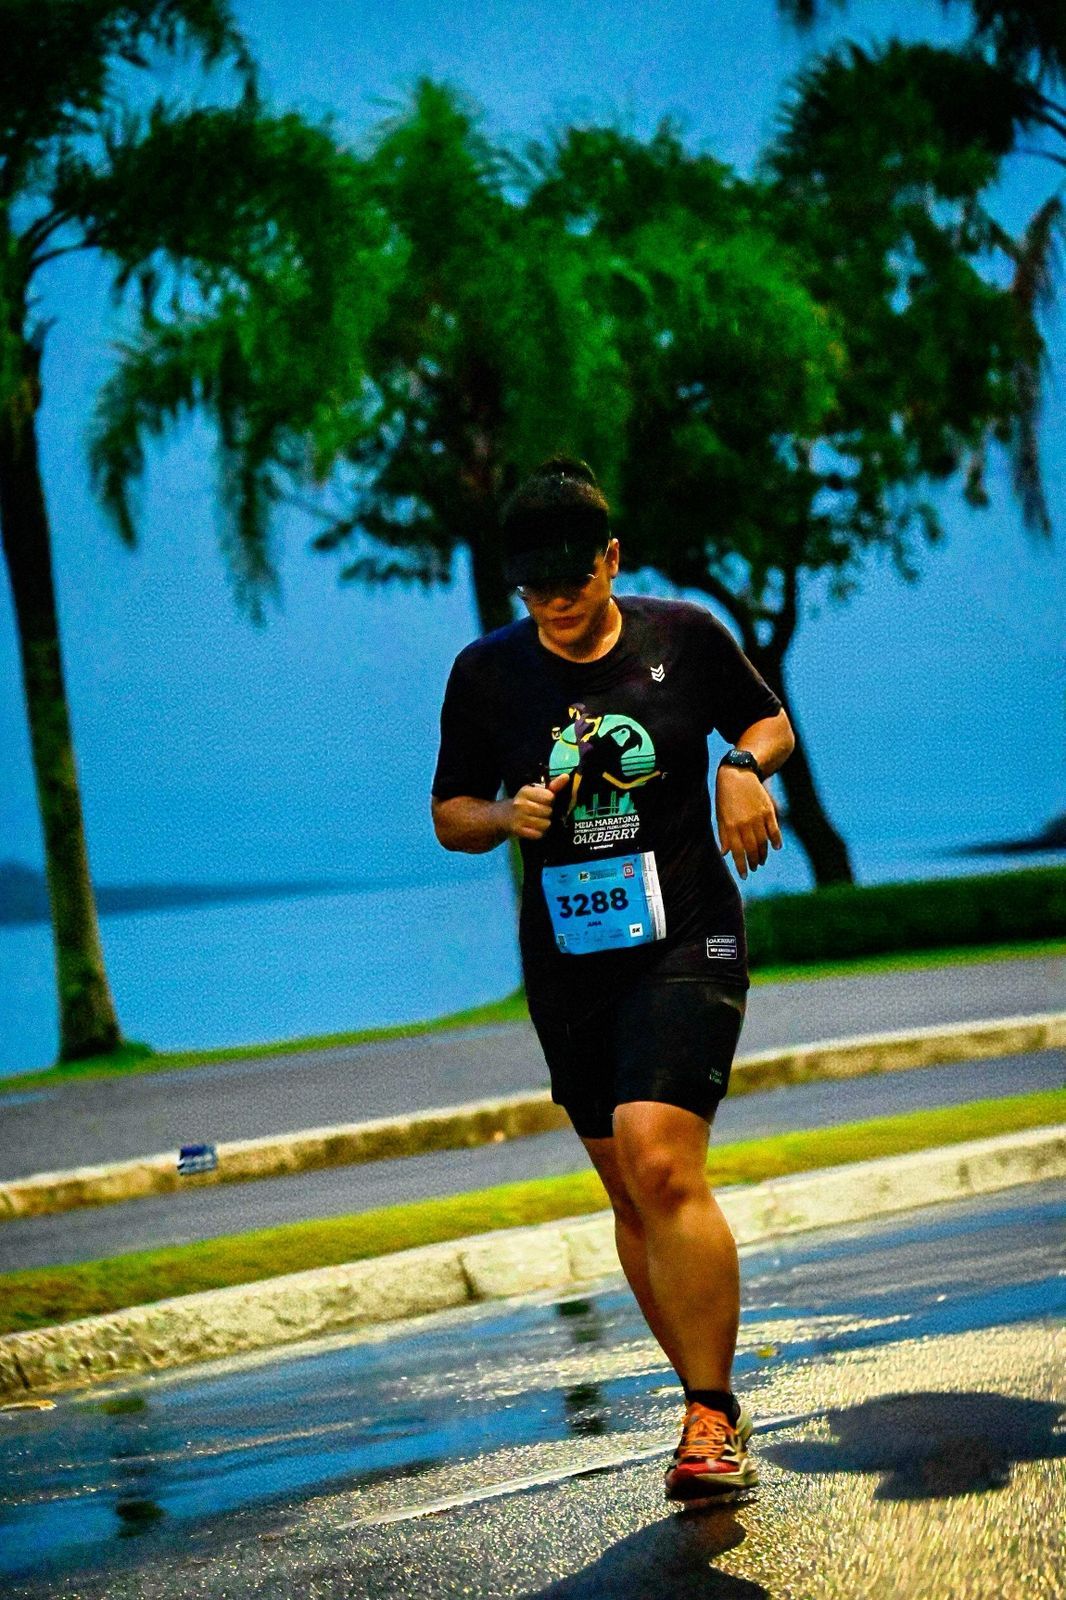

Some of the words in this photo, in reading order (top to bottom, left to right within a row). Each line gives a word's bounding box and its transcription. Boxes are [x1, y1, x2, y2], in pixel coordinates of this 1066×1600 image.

[574, 821, 594, 829] MEIA
[595, 815, 640, 827] MARATONA
[573, 827, 639, 845] OAKBERRY
[557, 887, 629, 919] 3288
